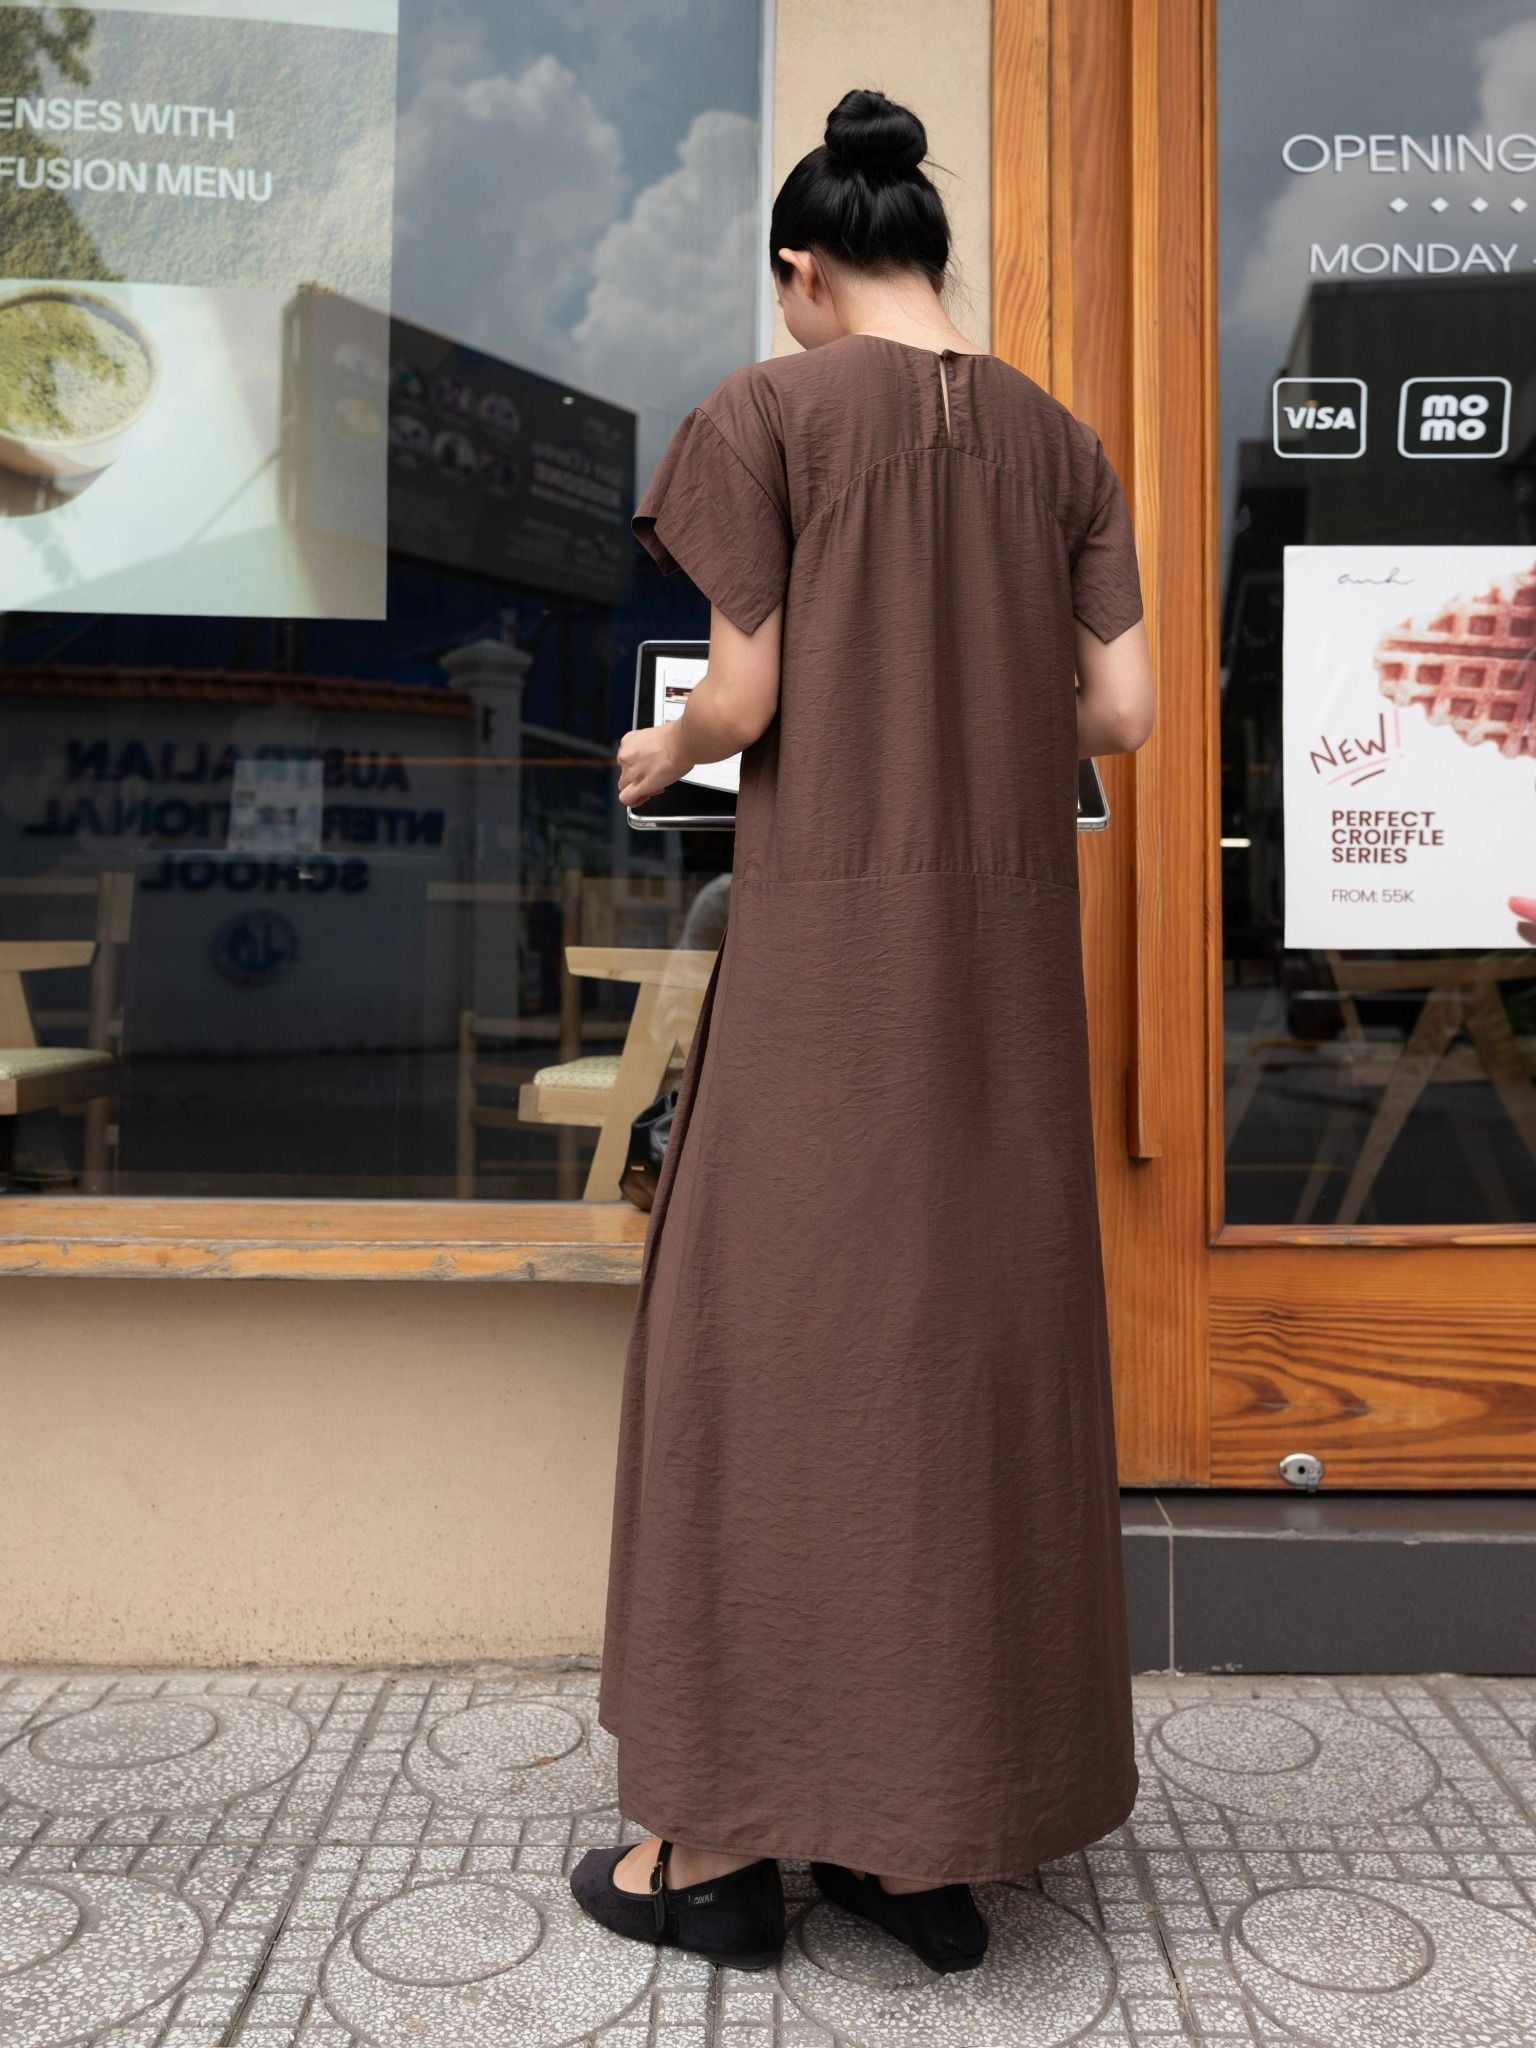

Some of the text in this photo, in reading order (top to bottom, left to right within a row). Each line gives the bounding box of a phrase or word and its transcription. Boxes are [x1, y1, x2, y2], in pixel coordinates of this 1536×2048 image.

[130, 102, 235, 140] WITH
[1282, 134, 1536, 173] OPENING
[0, 156, 273, 202] FUSION MENU
[1310, 243, 1519, 274] MONDAY
[1282, 406, 1357, 430] VISA
[1331, 811, 1437, 827] PERFECT
[1331, 829, 1445, 846] CROIFFLE
[1331, 847, 1408, 864] SERIES
[1331, 889, 1415, 903] FROM: 55K
